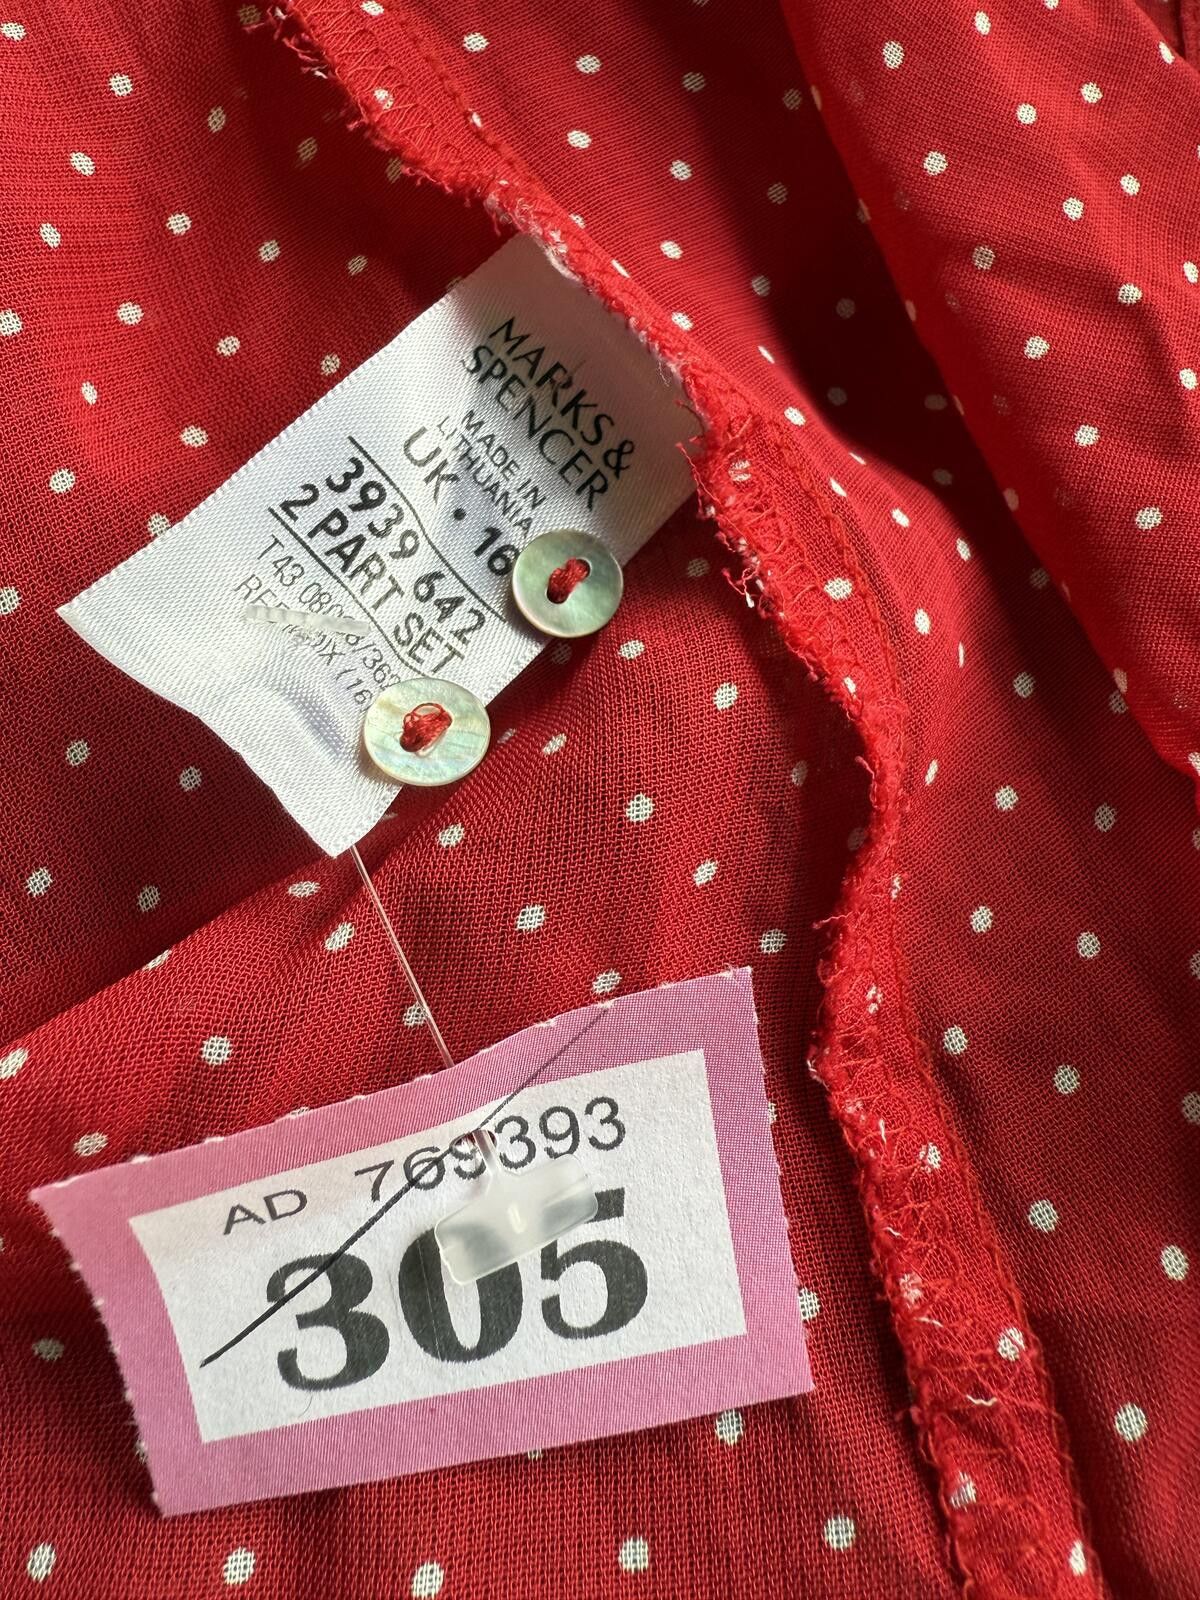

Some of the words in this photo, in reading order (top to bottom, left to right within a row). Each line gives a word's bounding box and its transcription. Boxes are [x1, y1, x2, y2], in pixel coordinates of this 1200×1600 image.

[461, 345, 609, 511] SPENCER
[461, 409, 520, 482] MADE
[516, 478, 546, 510] IN
[490, 316, 614, 450] MARKS
[603, 439, 635, 478] &
[326, 456, 422, 562] 3939
[412, 571, 487, 647] 642
[402, 426, 460, 506] UK
[474, 526, 521, 577] 16
[437, 415, 533, 539] LITHUANIA
[257, 533, 305, 587] T43
[279, 483, 321, 523] 2
[306, 510, 405, 613] PART
[391, 614, 466, 675] SET
[222, 1188, 309, 1236] AD
[354, 1096, 627, 1203] 769393
[265, 1187, 648, 1392] 305
